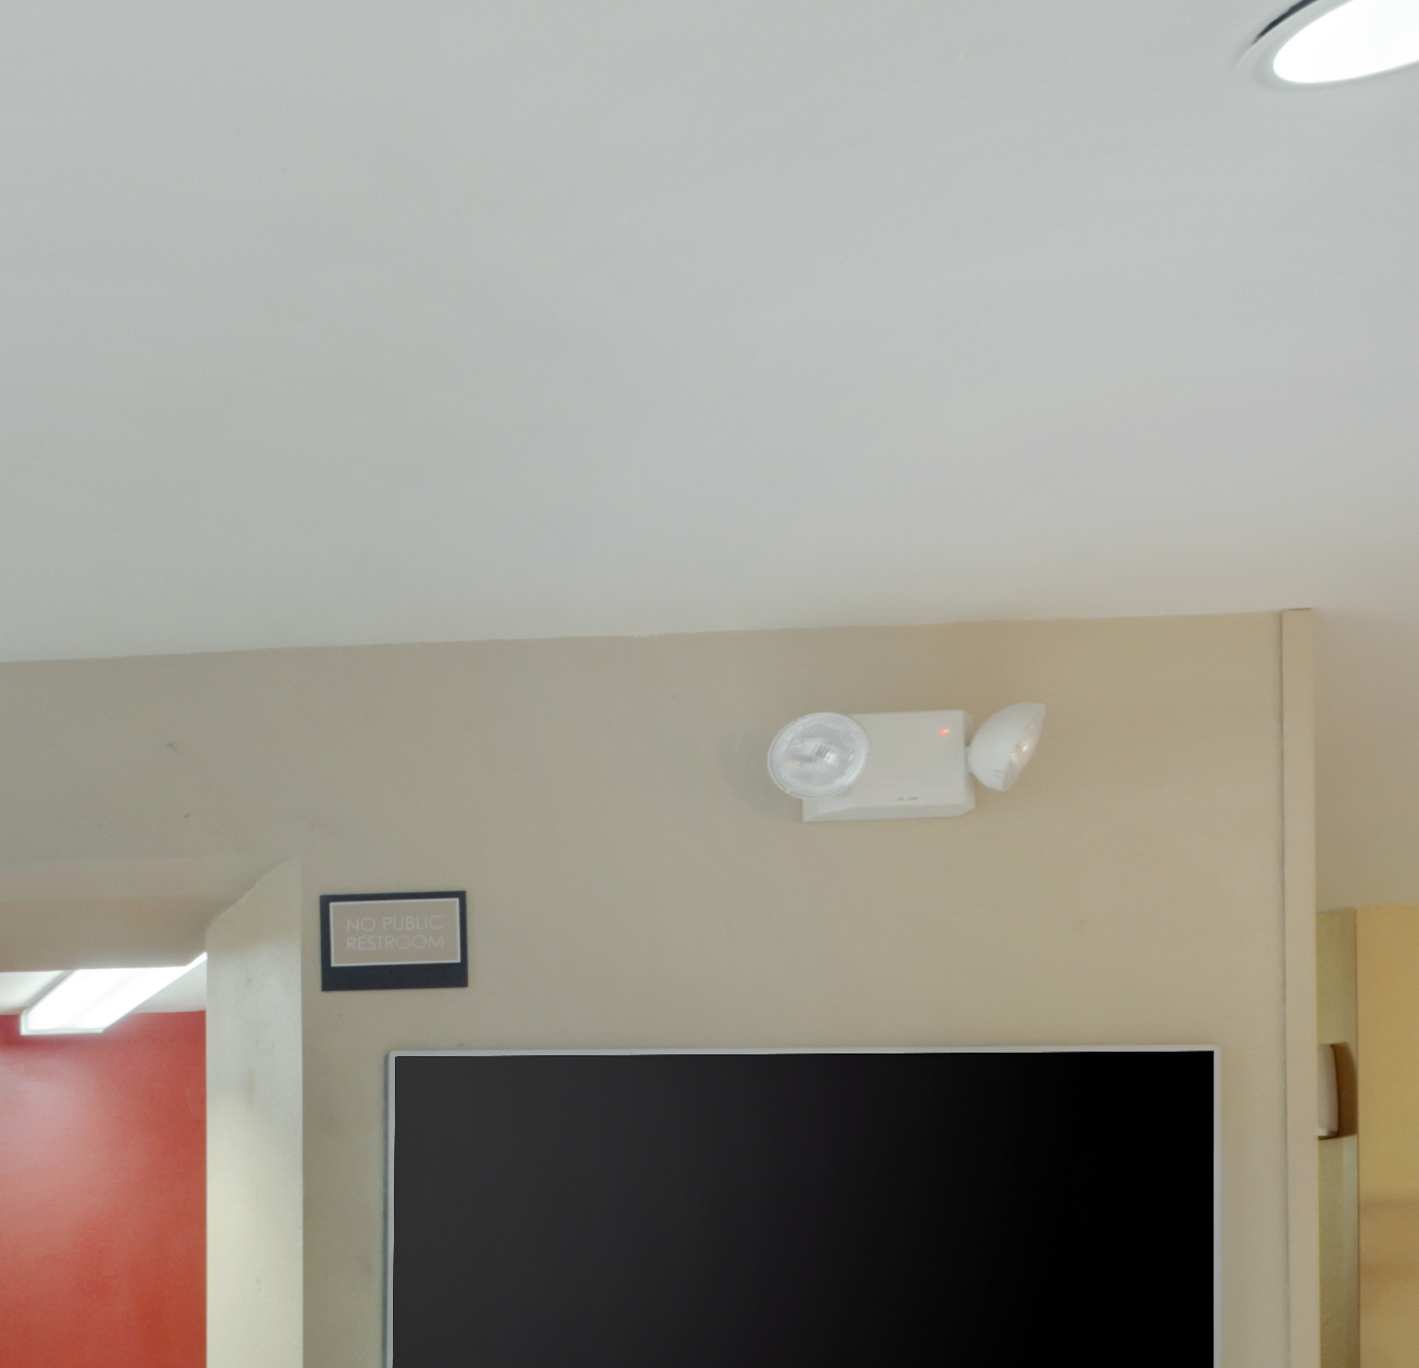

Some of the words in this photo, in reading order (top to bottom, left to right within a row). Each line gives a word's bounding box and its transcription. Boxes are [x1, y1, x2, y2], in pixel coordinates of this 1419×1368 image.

[347, 917, 376, 932] NO
[383, 915, 443, 931] PUBLIC
[347, 934, 444, 950] RESTROOM
